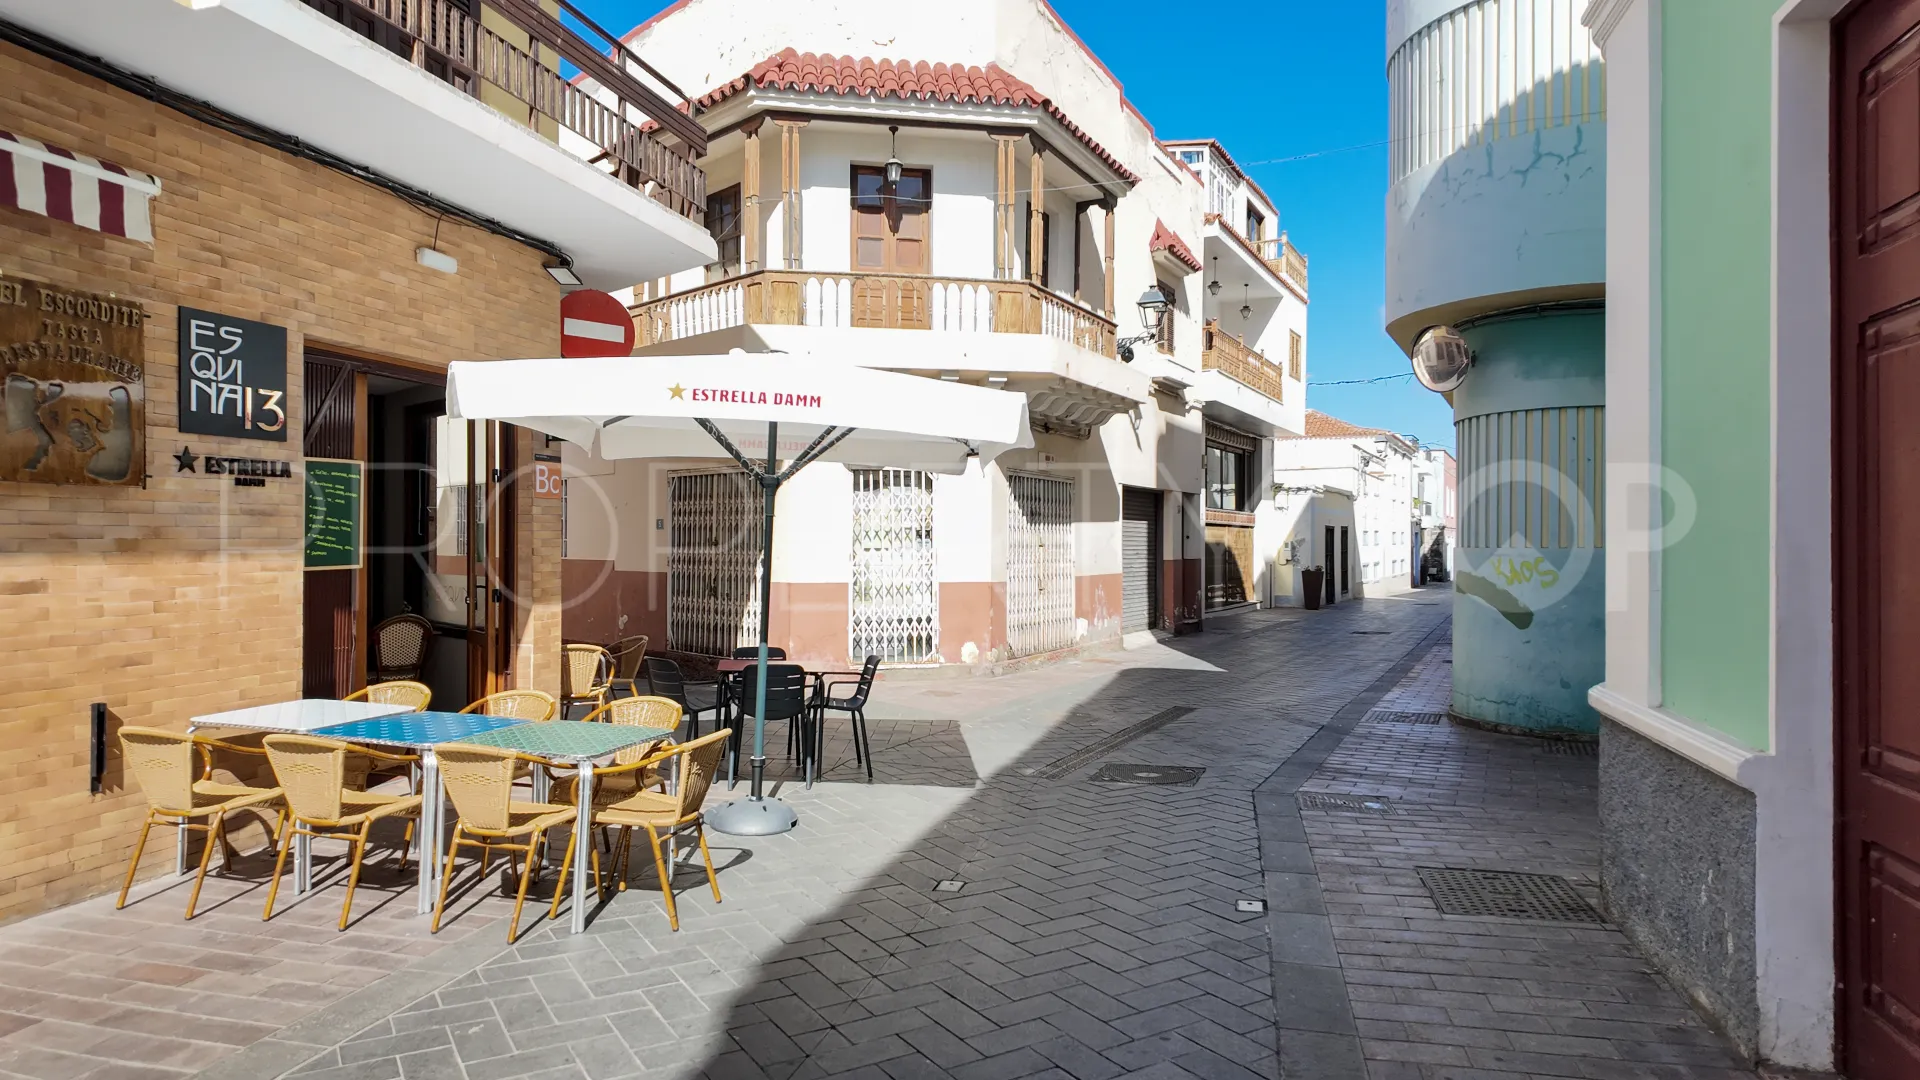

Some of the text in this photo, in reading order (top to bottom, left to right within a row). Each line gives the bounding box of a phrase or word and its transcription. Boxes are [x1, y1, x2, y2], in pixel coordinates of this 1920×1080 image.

[0, 281, 141, 328] EL ESCONDITE
[42, 318, 103, 345] TASCA
[190, 319, 243, 354] ES
[692, 388, 822, 408] ESTRELLA DAMM
[205, 456, 292, 478] ESTRELLA
[535, 464, 560, 494] Bc
[234, 477, 266, 487] DAMM
[1488, 556, 1560, 590] KAOS
